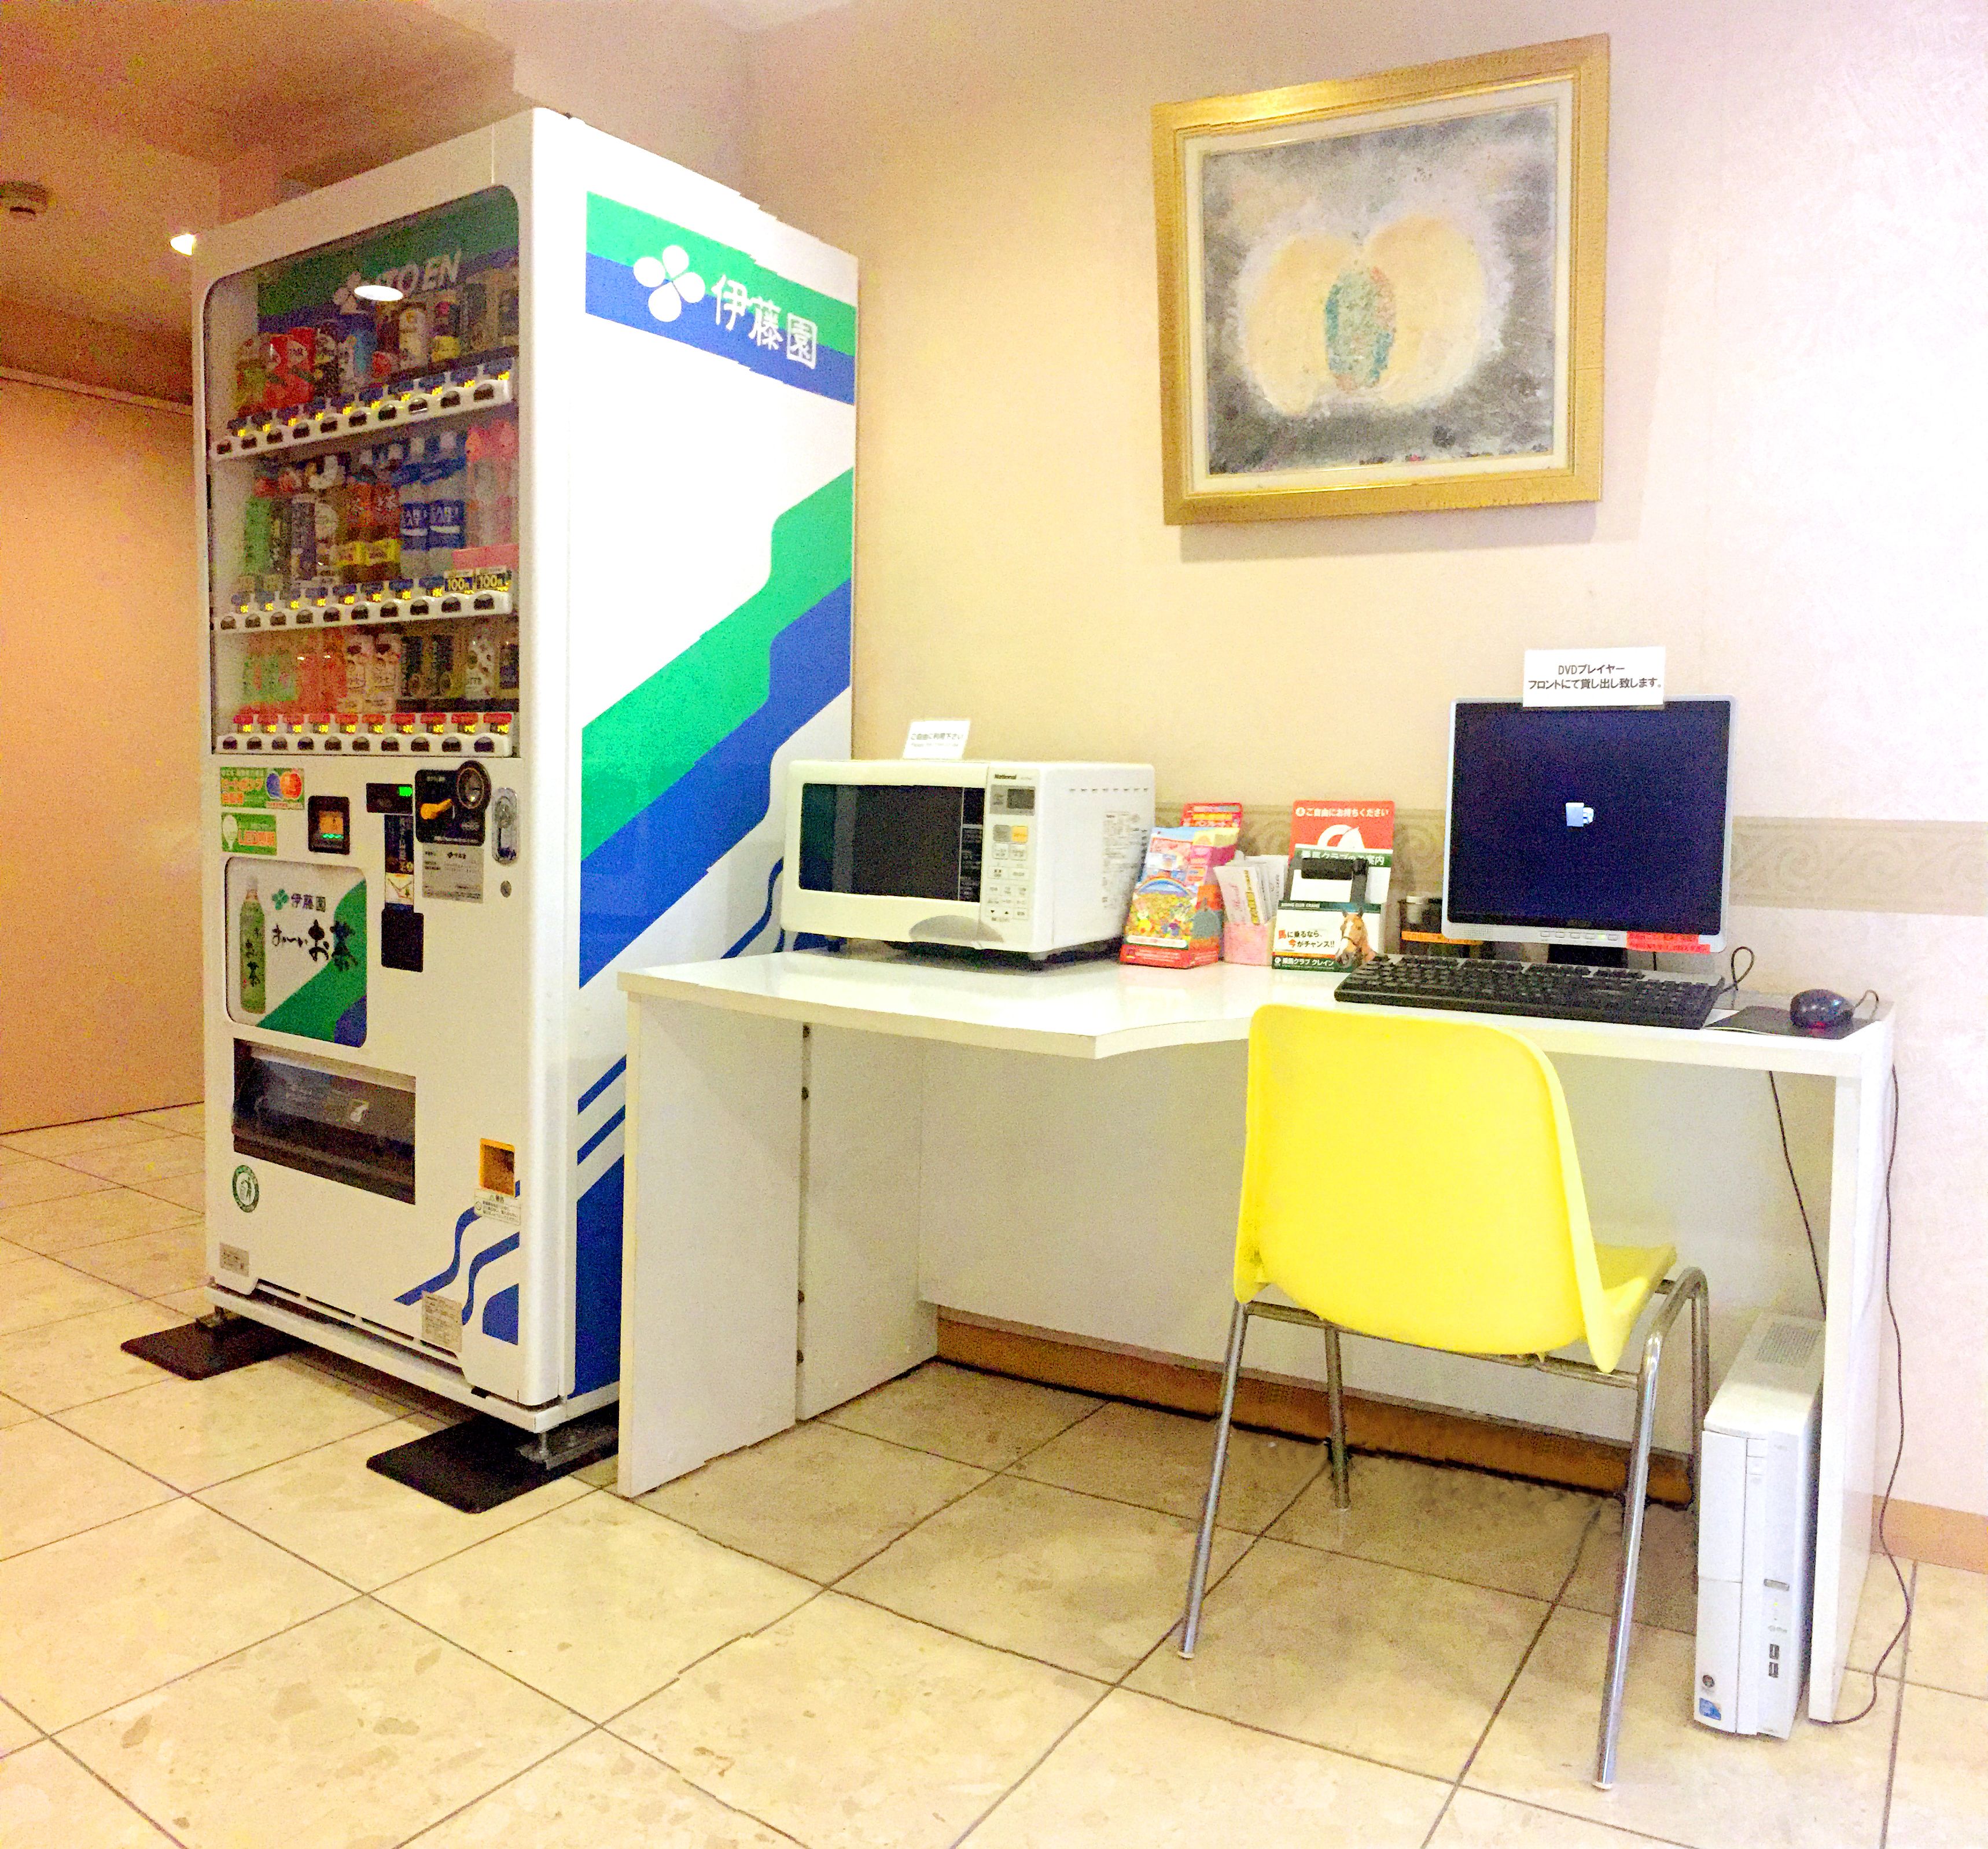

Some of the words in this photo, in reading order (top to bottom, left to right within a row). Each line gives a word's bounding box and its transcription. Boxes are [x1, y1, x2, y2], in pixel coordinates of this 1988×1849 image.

[710, 274, 818, 369] 伊藤園
[1558, 664, 1625, 675] DVDプレイヤー
[1528, 677, 1661, 689] フロントにて貸し出し致します。
[1306, 807, 1389, 817] ご自由にお持ちください
